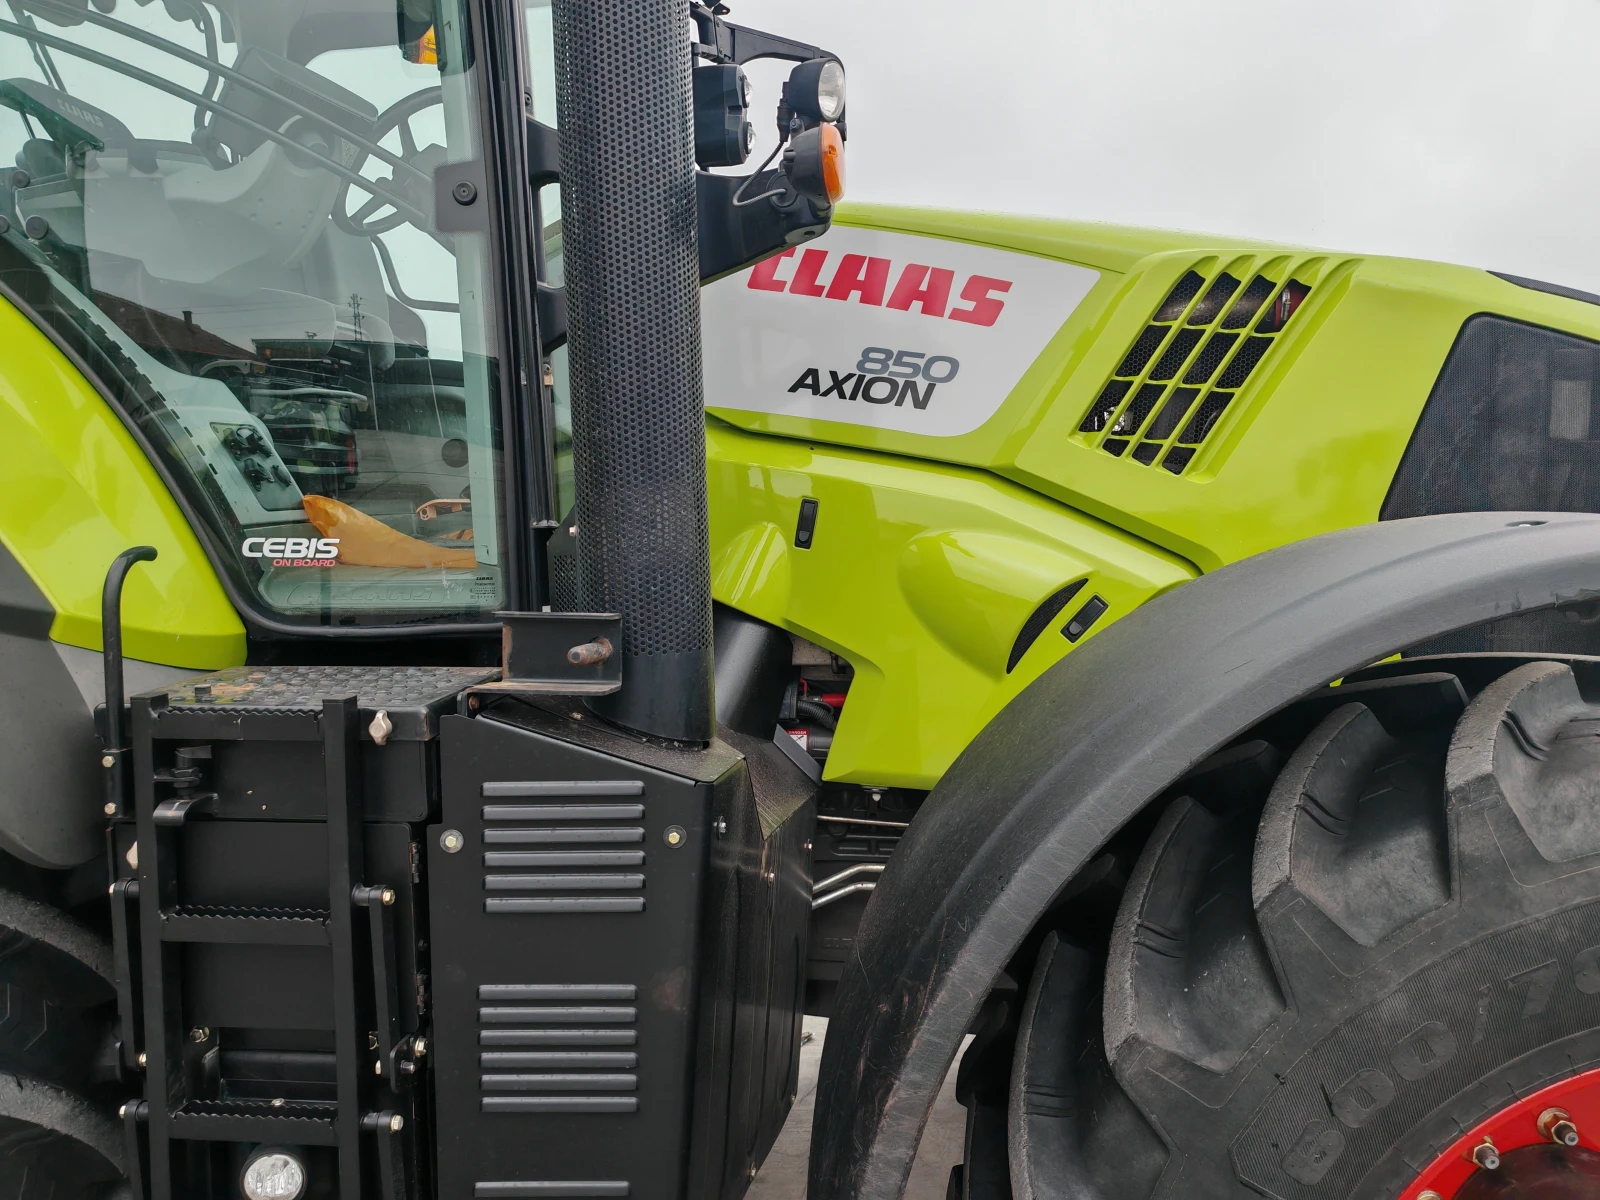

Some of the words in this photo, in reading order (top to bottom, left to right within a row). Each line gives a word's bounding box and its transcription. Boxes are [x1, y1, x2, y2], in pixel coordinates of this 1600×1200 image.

[747, 246, 1014, 327] CLAAS
[856, 346, 960, 384] 850
[787, 367, 937, 410] AXION
[241, 537, 340, 559] CEBIS
[272, 558, 291, 568] ON
[293, 559, 336, 568] BOARD
